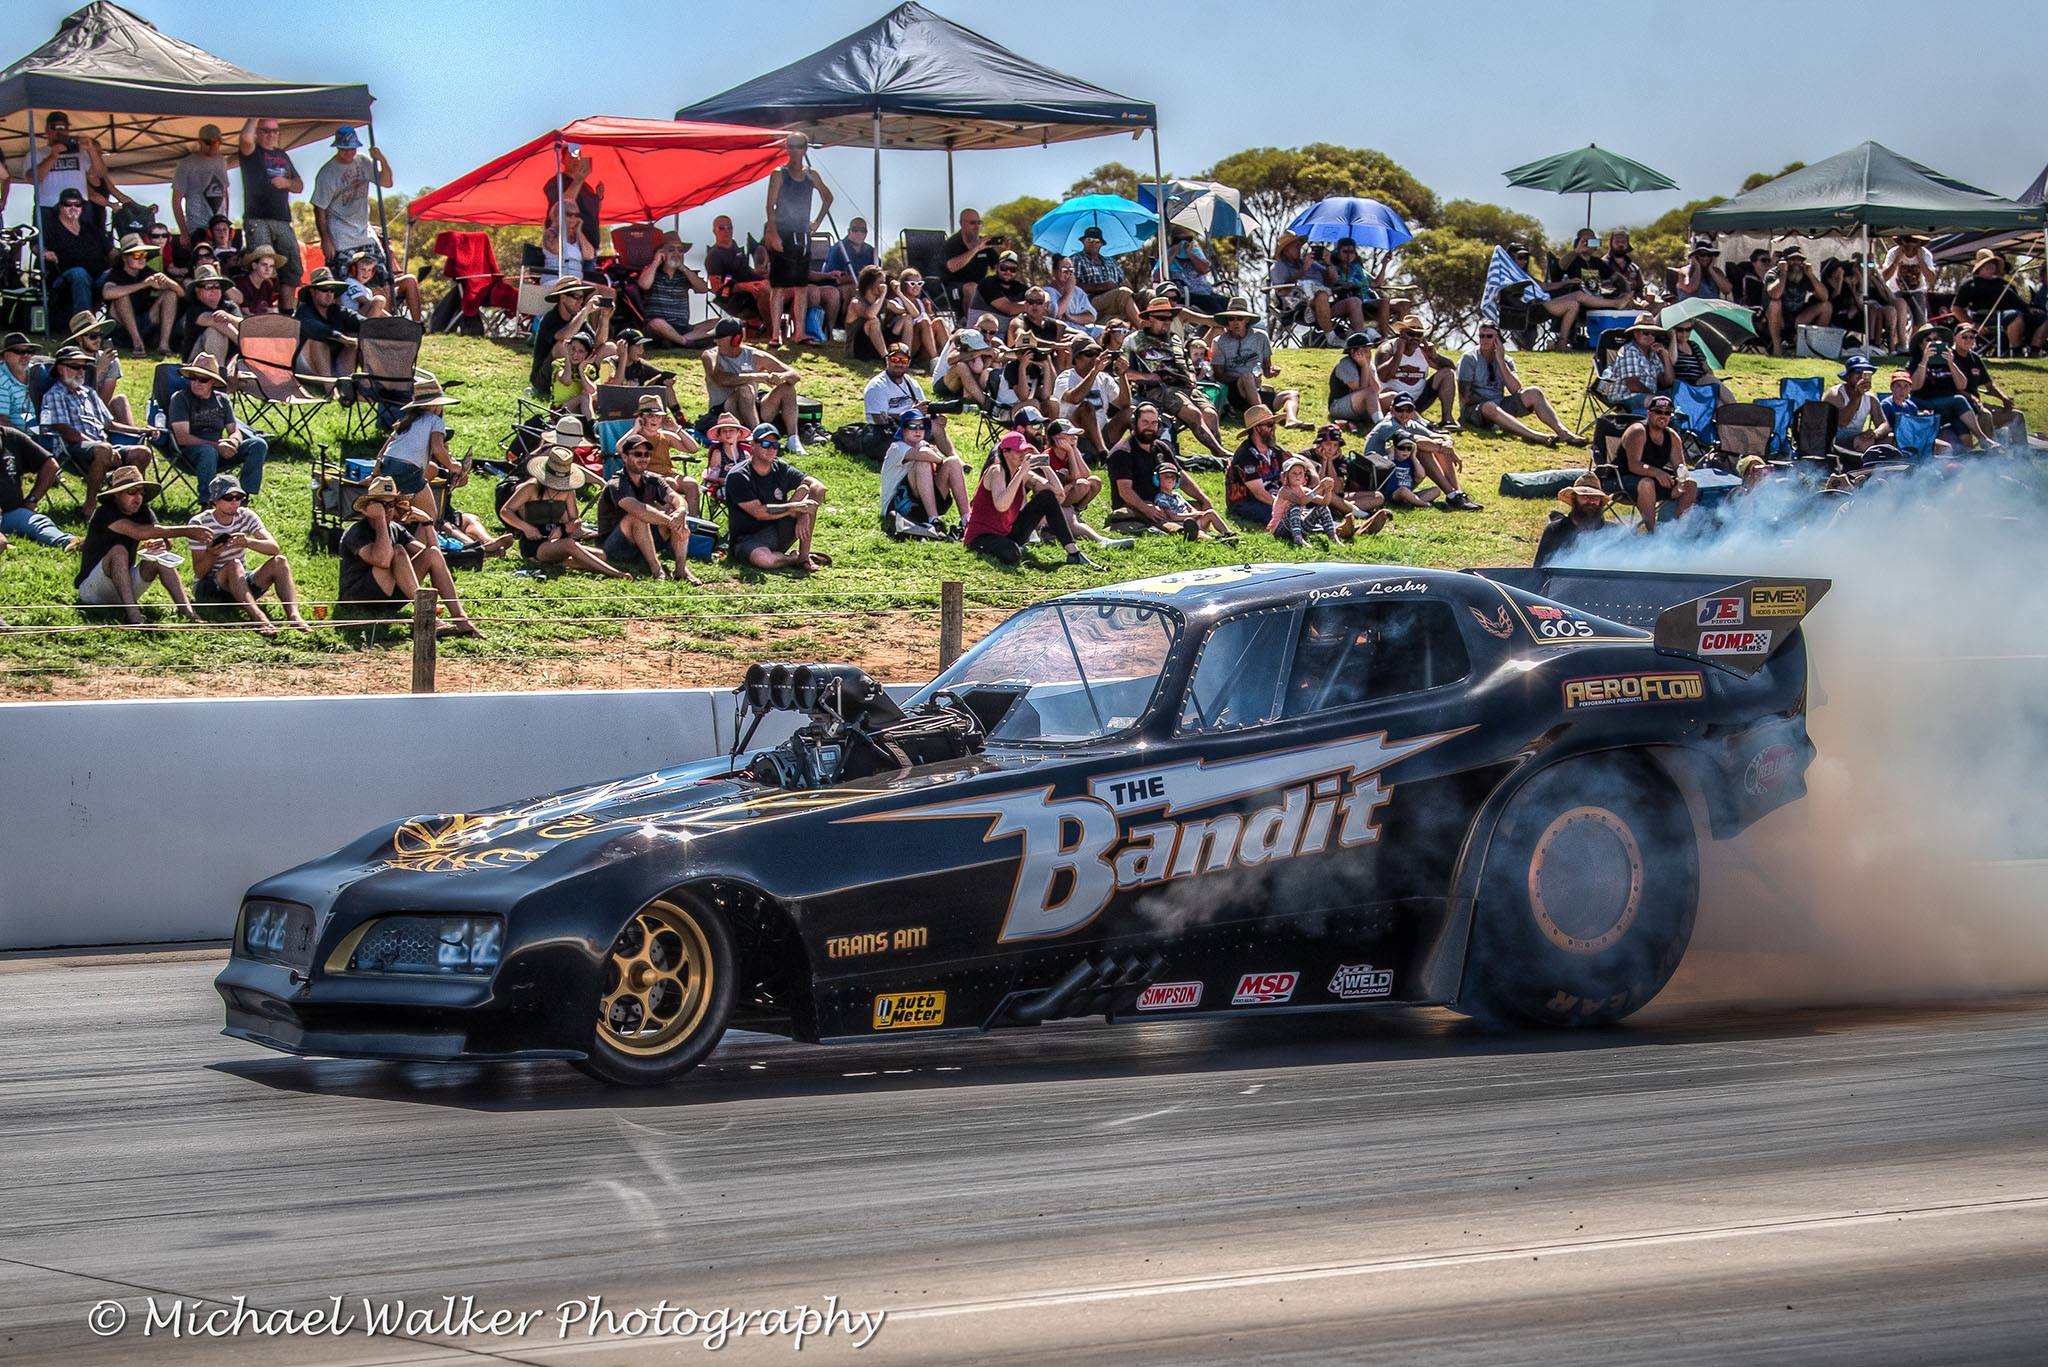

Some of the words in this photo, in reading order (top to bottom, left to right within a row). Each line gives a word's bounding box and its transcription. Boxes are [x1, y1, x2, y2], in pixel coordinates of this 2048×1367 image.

[1309, 587, 1352, 606] Josh
[1366, 581, 1429, 595] Leahy
[1752, 591, 1794, 603] BME
[1699, 599, 1739, 623] JE
[1540, 620, 1594, 637] 605
[1702, 633, 1754, 650] COMP
[1566, 675, 1702, 708] AEROFLOW
[1579, 699, 1616, 707] PERFORMANCE
[1111, 776, 1164, 805] THE
[999, 775, 1395, 943] Bandit
[826, 932, 888, 958] TRANS
[894, 927, 928, 949] AM
[1238, 974, 1293, 995] MSD
[1344, 973, 1390, 989] WELD
[896, 994, 936, 1010] Auto
[1143, 986, 1196, 1005] SIMPSON
[893, 1009, 941, 1022] Meter
